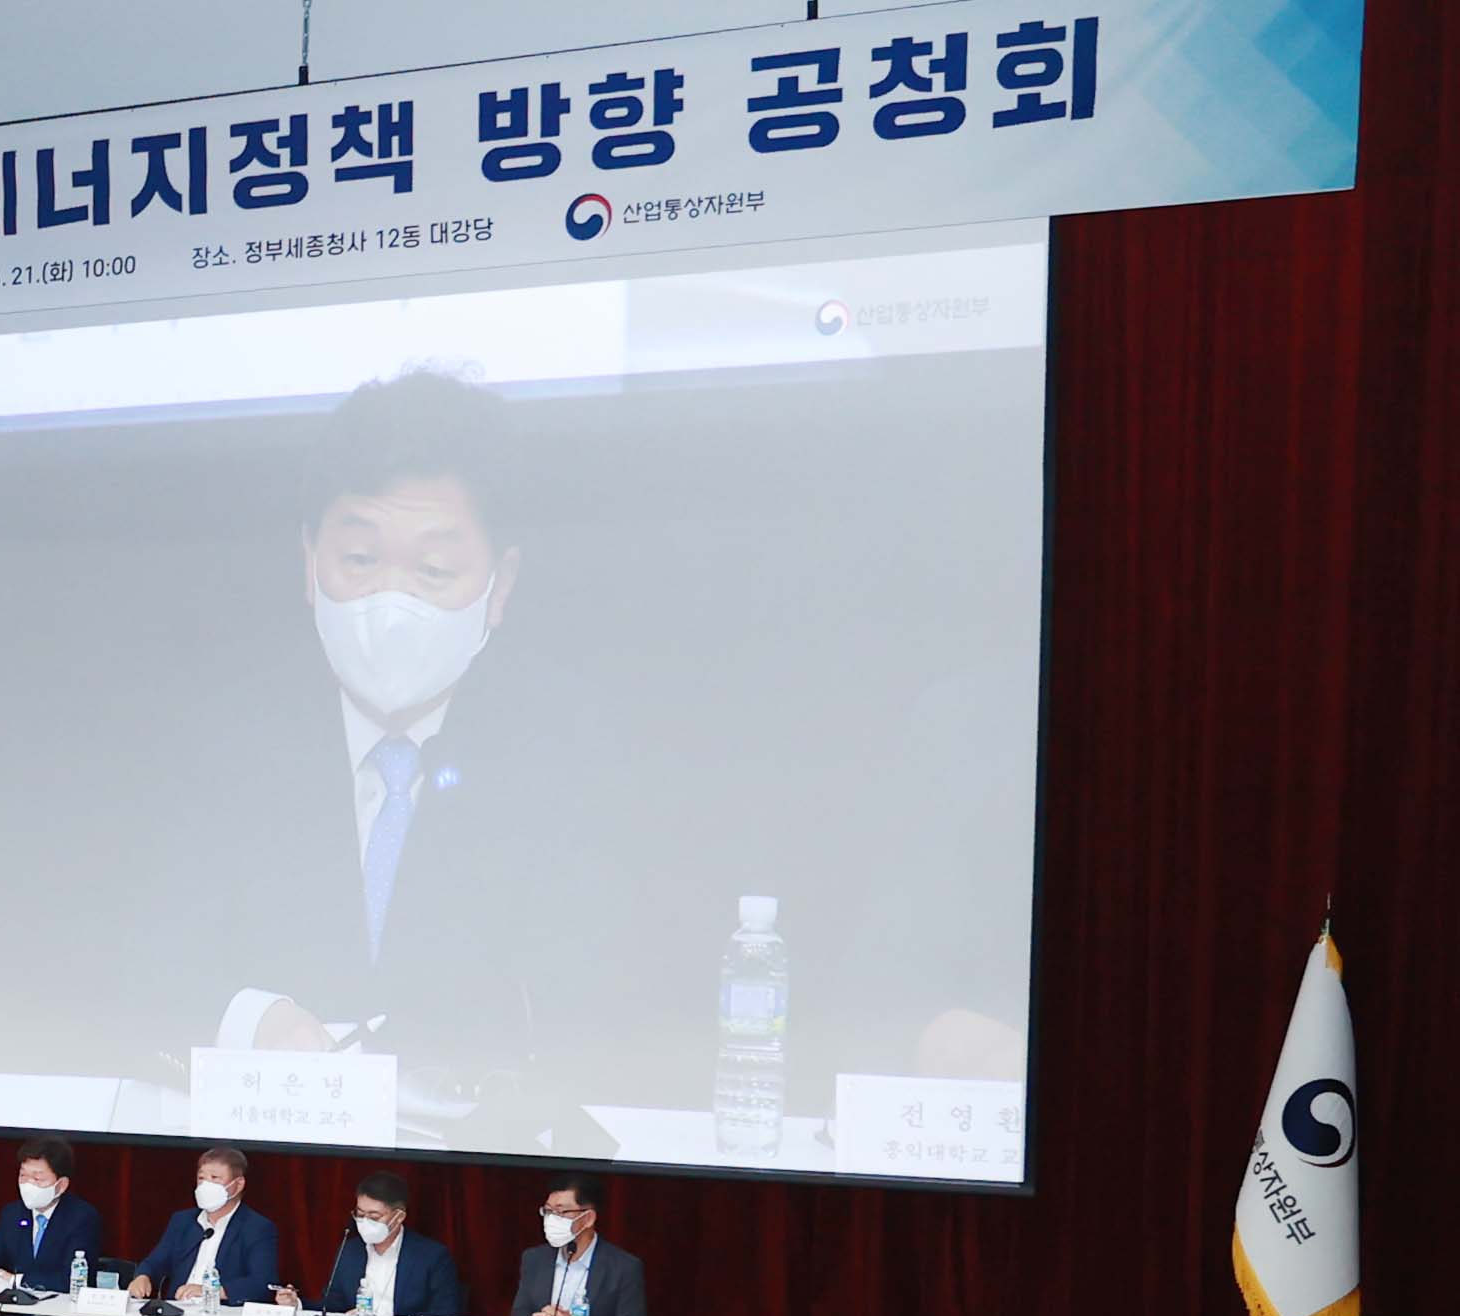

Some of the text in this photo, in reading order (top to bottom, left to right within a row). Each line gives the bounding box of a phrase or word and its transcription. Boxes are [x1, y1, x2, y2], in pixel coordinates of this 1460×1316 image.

[478, 66, 684, 184] 방향
[746, 15, 1100, 154] 공청회
[622, 189, 766, 225] 산업통상자원부
[11, 258, 74, 287] 21.(화)
[81, 255, 137, 280] 10:00
[191, 245, 237, 270] 장소.
[244, 230, 368, 264] 정부세종청사
[375, 223, 421, 250] 12동
[430, 216, 495, 246] 대강당
